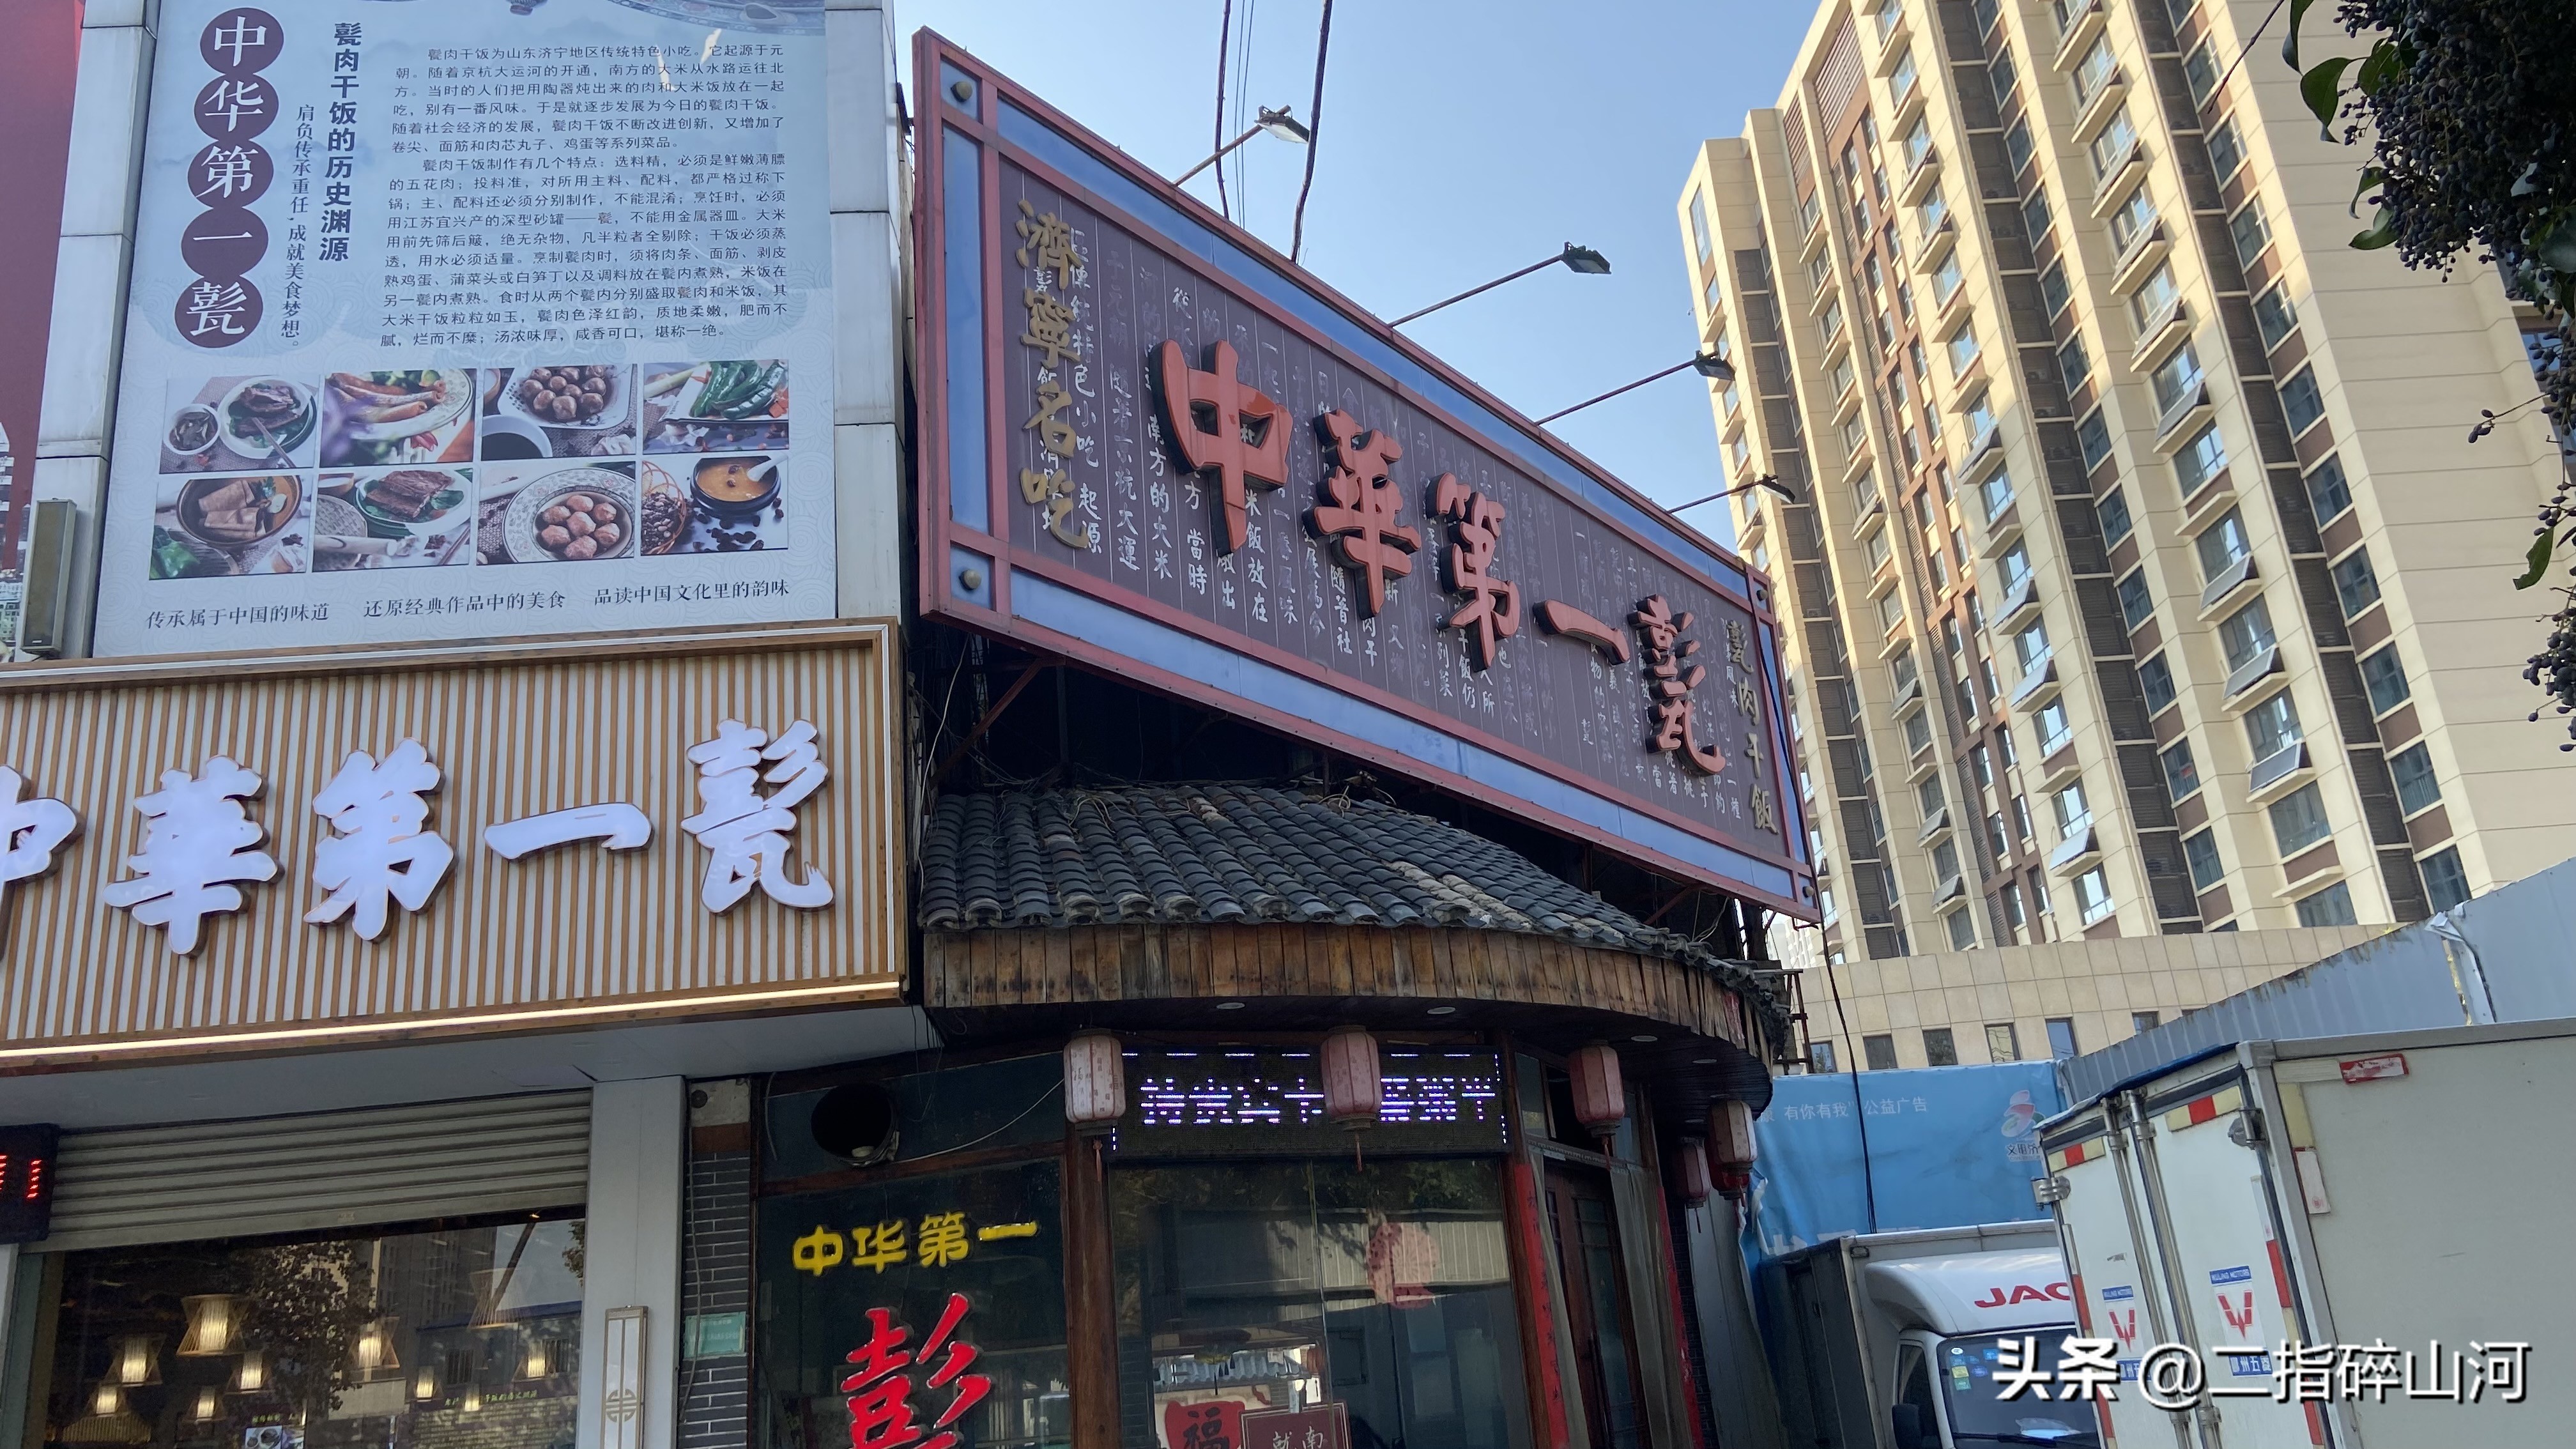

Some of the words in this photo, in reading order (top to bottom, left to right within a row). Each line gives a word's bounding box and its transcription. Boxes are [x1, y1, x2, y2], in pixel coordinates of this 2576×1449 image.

[319, 22, 362, 263] 甏肉干饭的历史渊源
[188, 16, 266, 337] 中华第一甏
[146, 602, 330, 629] 传承属于中国的味道
[364, 590, 565, 618] 还原经典作品中的美食
[594, 579, 789, 606] 品读中国文化里的韵味
[1864, 1096, 1927, 1115] 公益广告
[792, 1211, 1038, 1276] 中华第一
